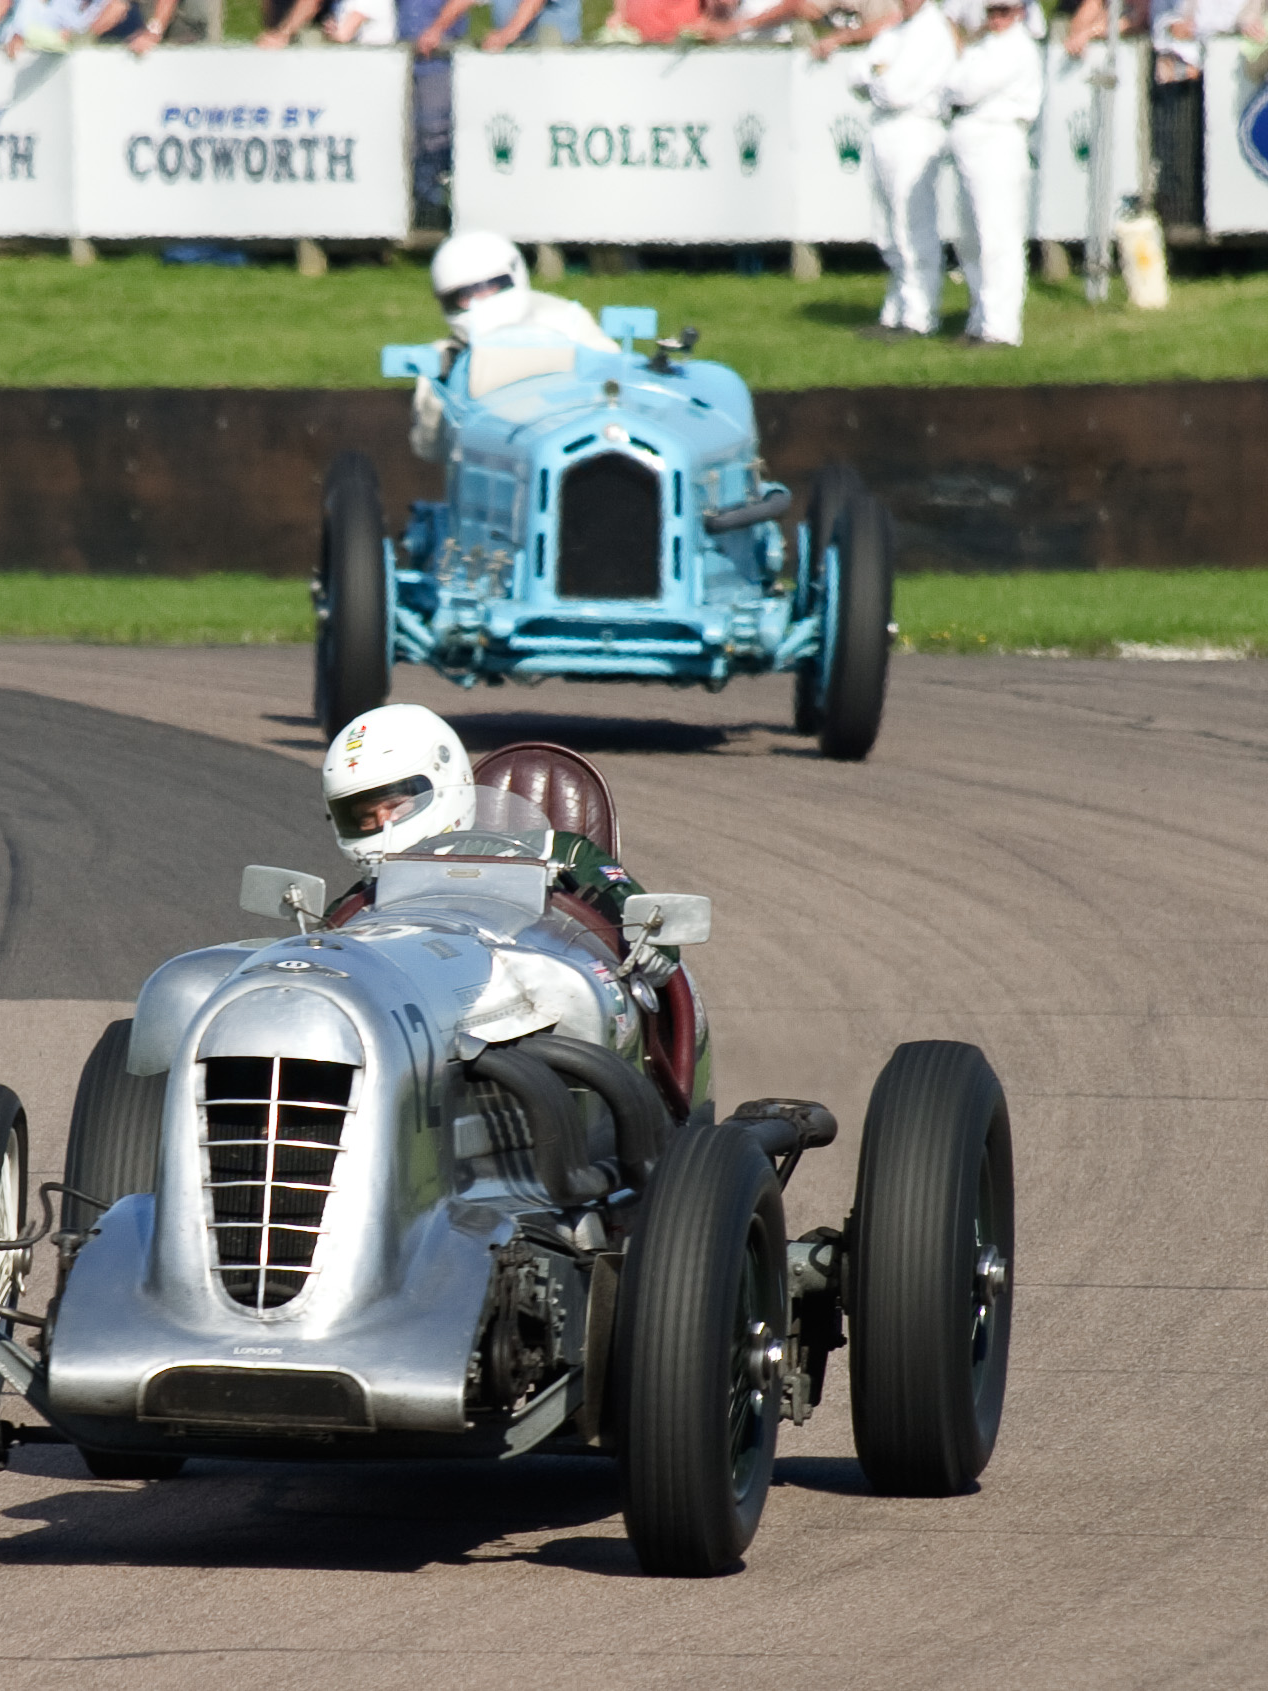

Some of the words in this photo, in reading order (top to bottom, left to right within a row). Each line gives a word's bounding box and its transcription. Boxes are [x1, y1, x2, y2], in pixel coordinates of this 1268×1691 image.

[162, 105, 272, 128] POWER
[282, 105, 325, 128] BY
[126, 134, 358, 184] COSWORTH
[546, 122, 712, 170] ROLEX
[390, 1003, 442, 1134] 12
[232, 1345, 284, 1356] LONDON
